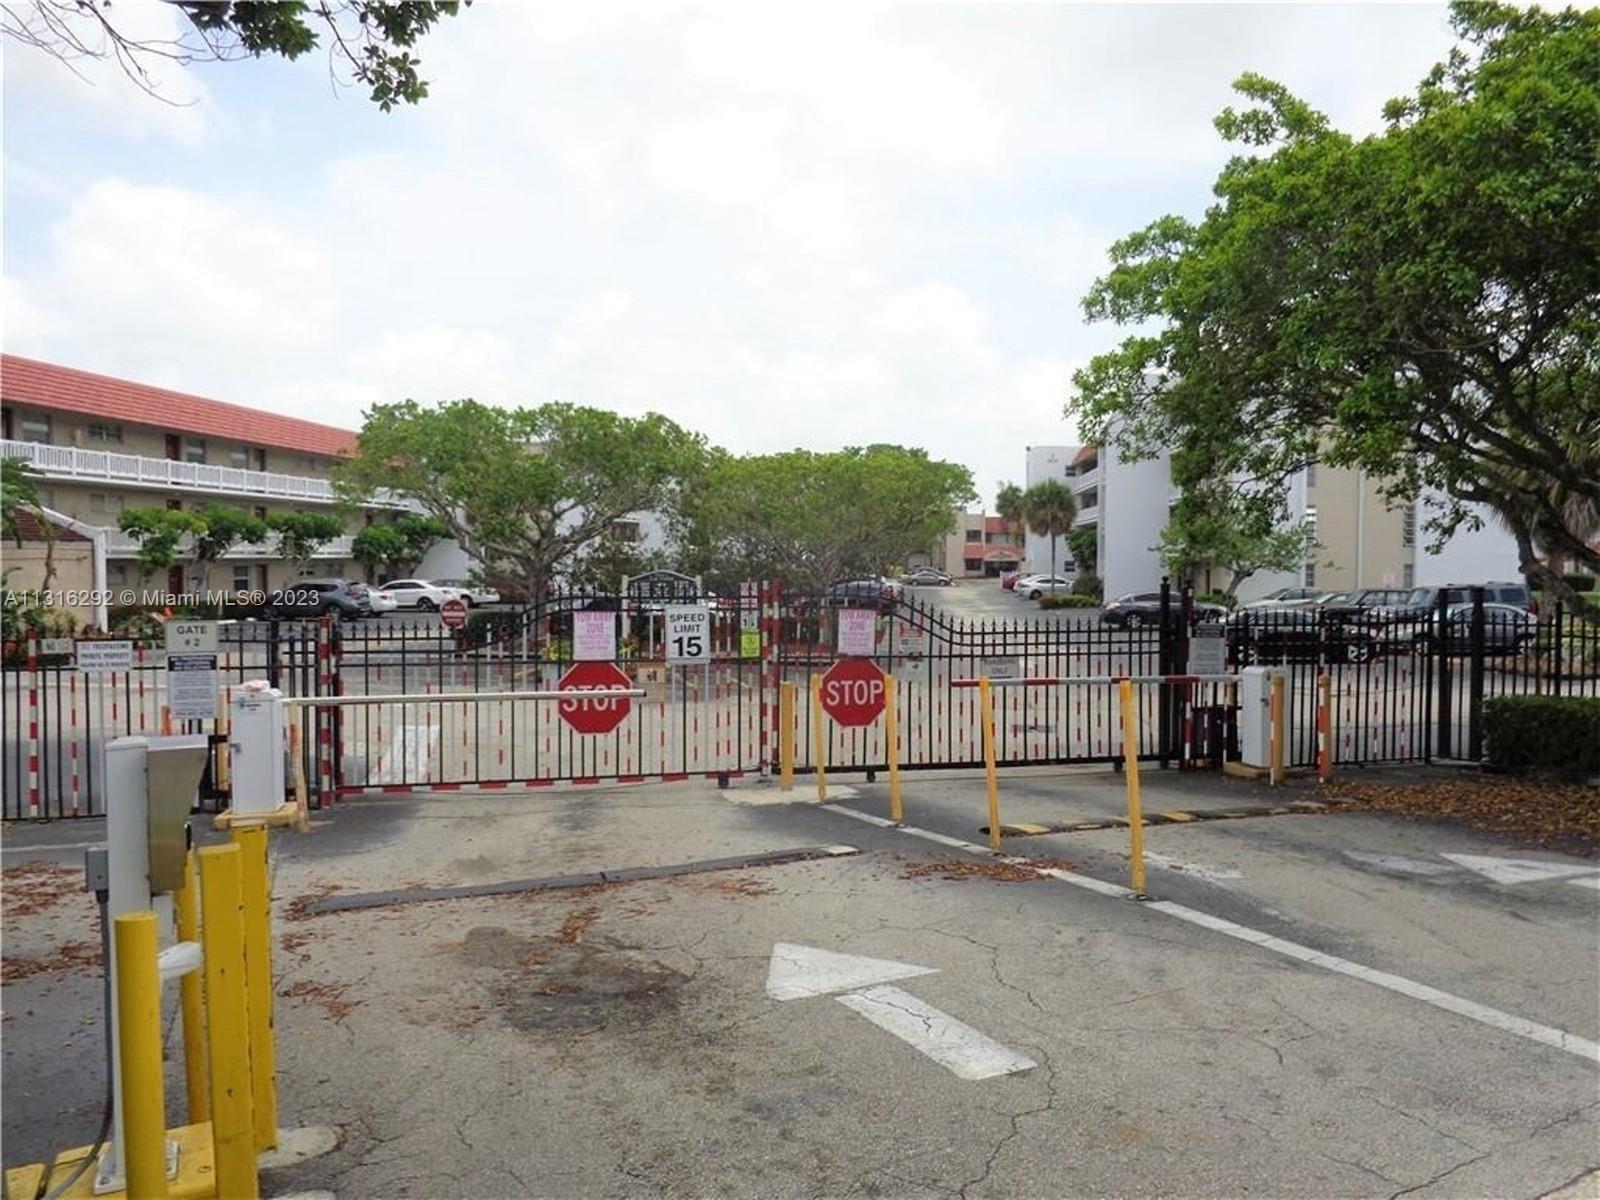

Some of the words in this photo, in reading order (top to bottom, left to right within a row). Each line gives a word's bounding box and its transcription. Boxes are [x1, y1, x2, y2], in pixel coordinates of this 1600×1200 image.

[669, 613, 705, 622] SPEED
[176, 625, 208, 635] GATE
[674, 624, 701, 633] LIMIT
[672, 636, 702, 657] 15
[562, 684, 628, 712] STOP
[826, 680, 884, 706] STOP
